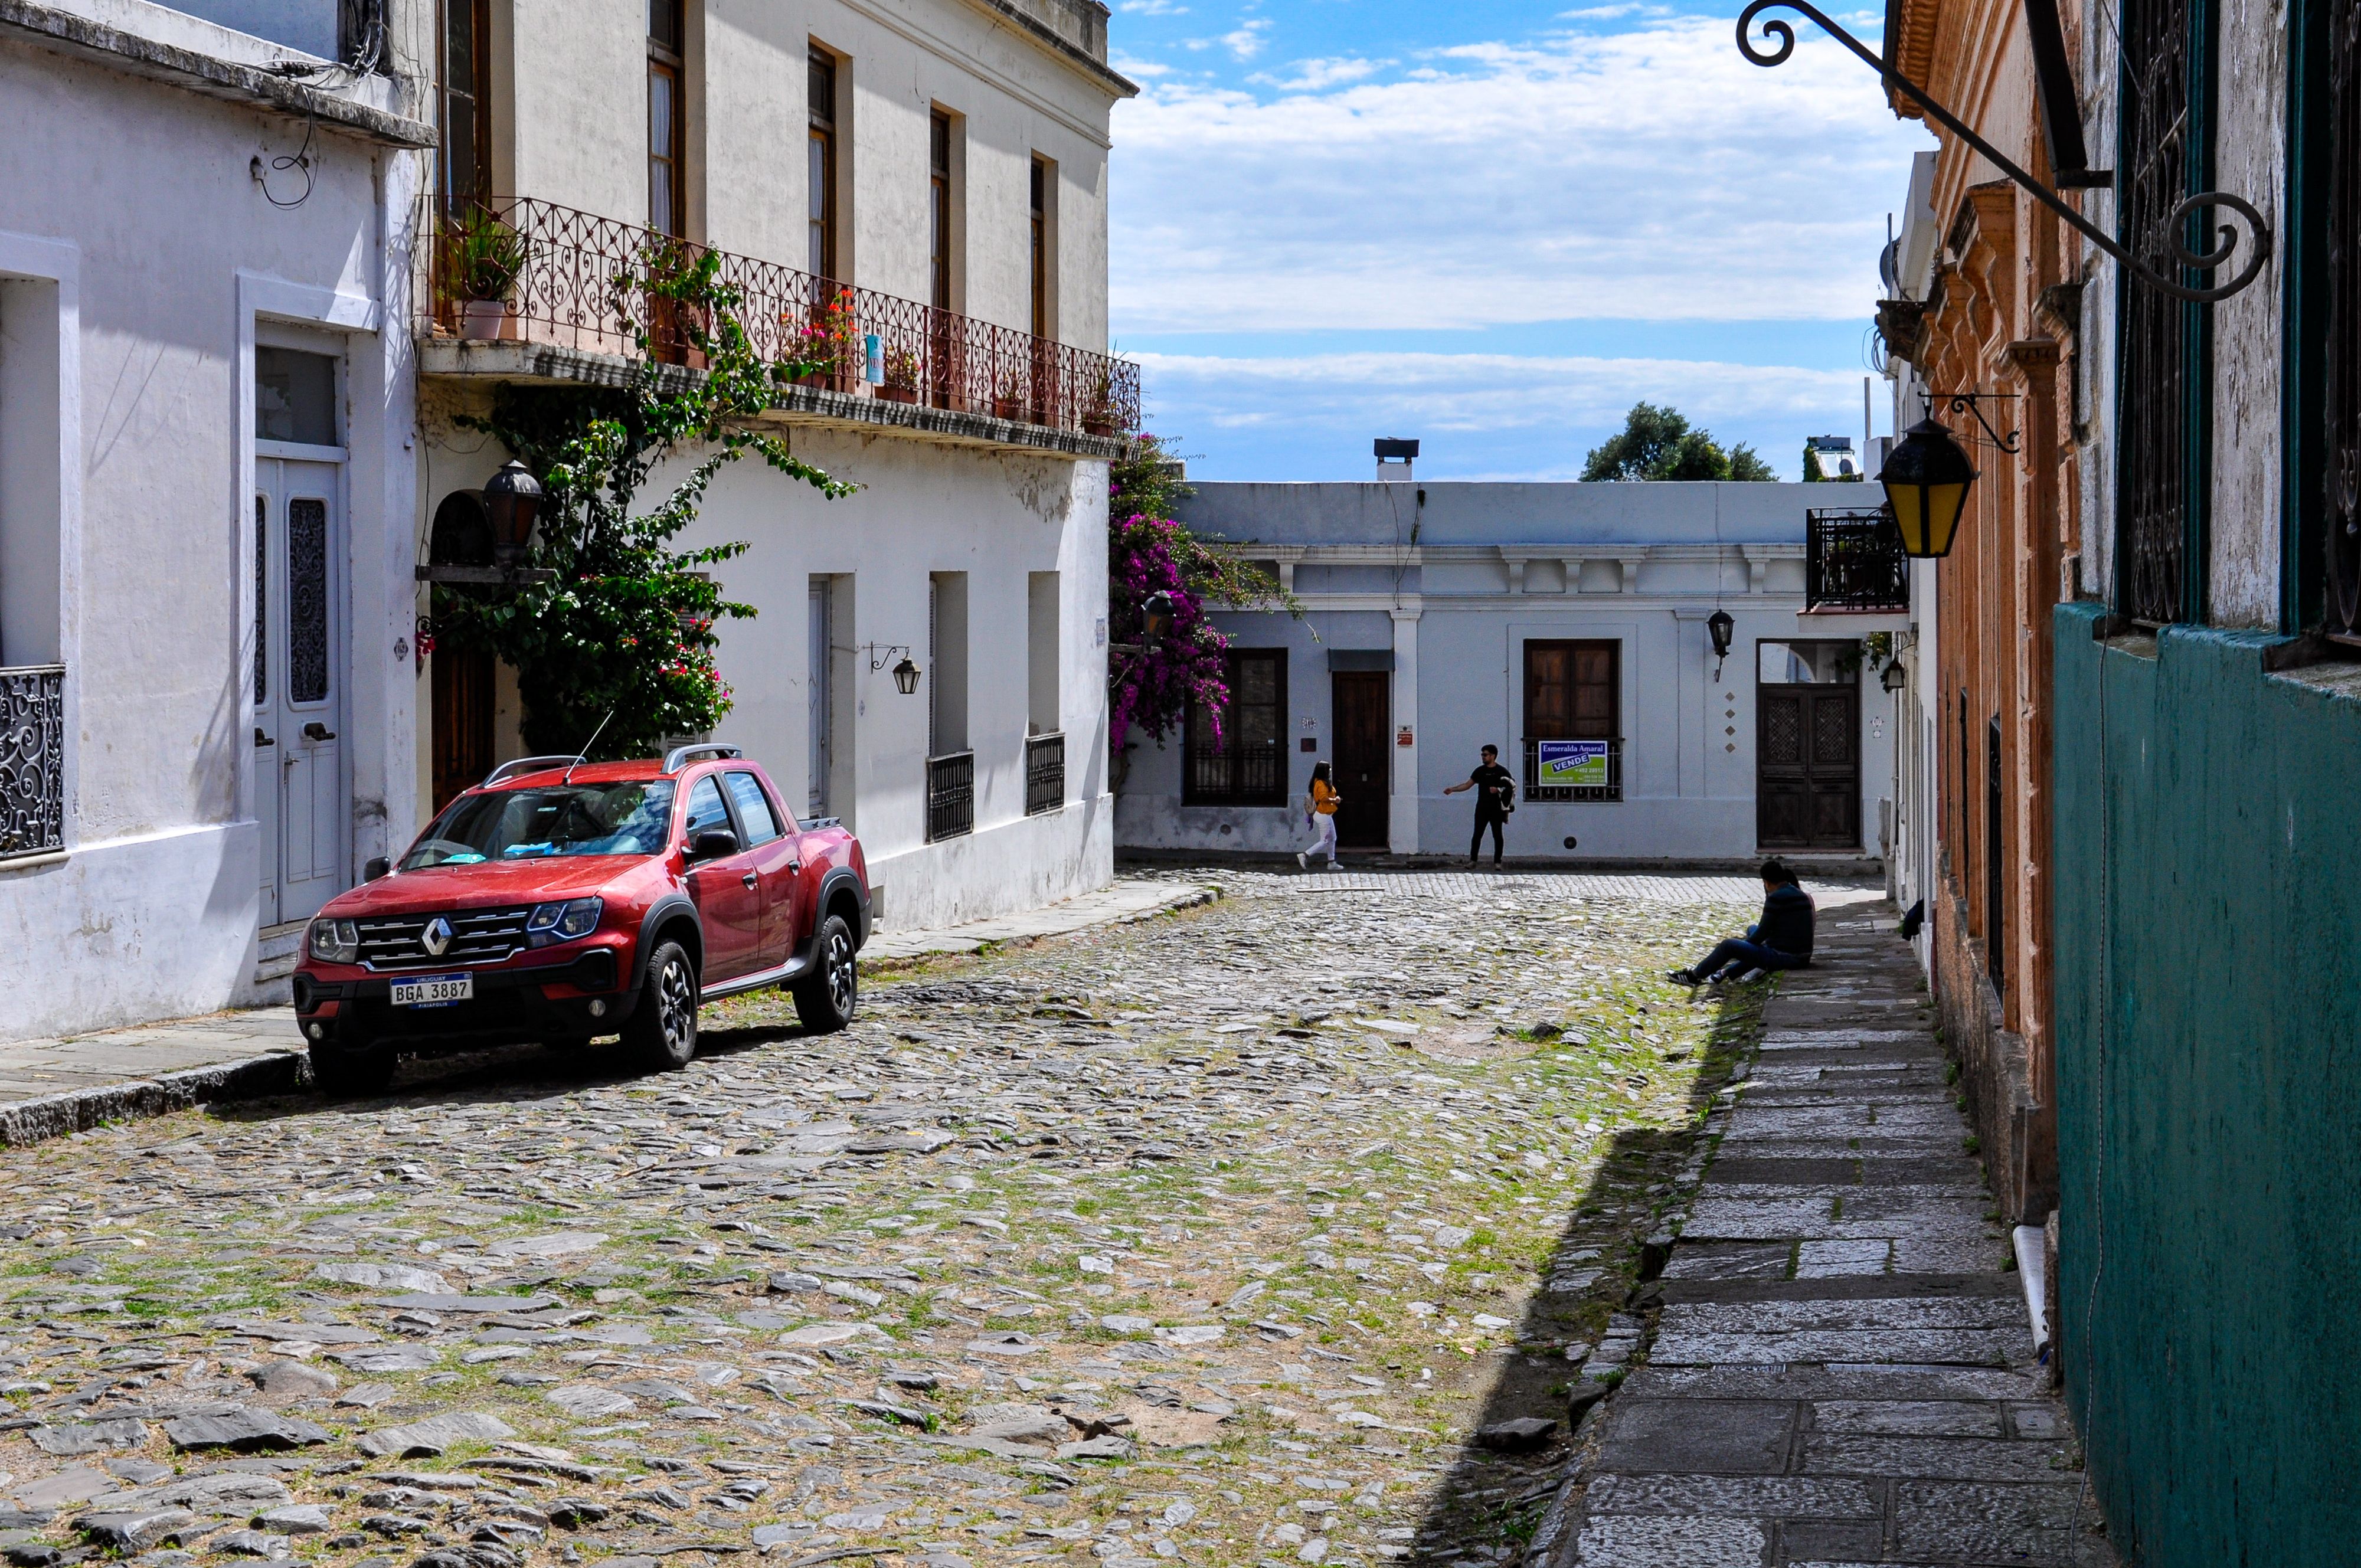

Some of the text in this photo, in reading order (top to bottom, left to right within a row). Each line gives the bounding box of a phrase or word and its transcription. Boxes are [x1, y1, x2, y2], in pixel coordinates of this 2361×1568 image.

[1554, 755, 1588, 771] VENDE
[396, 981, 467, 1001] BGA 3887
